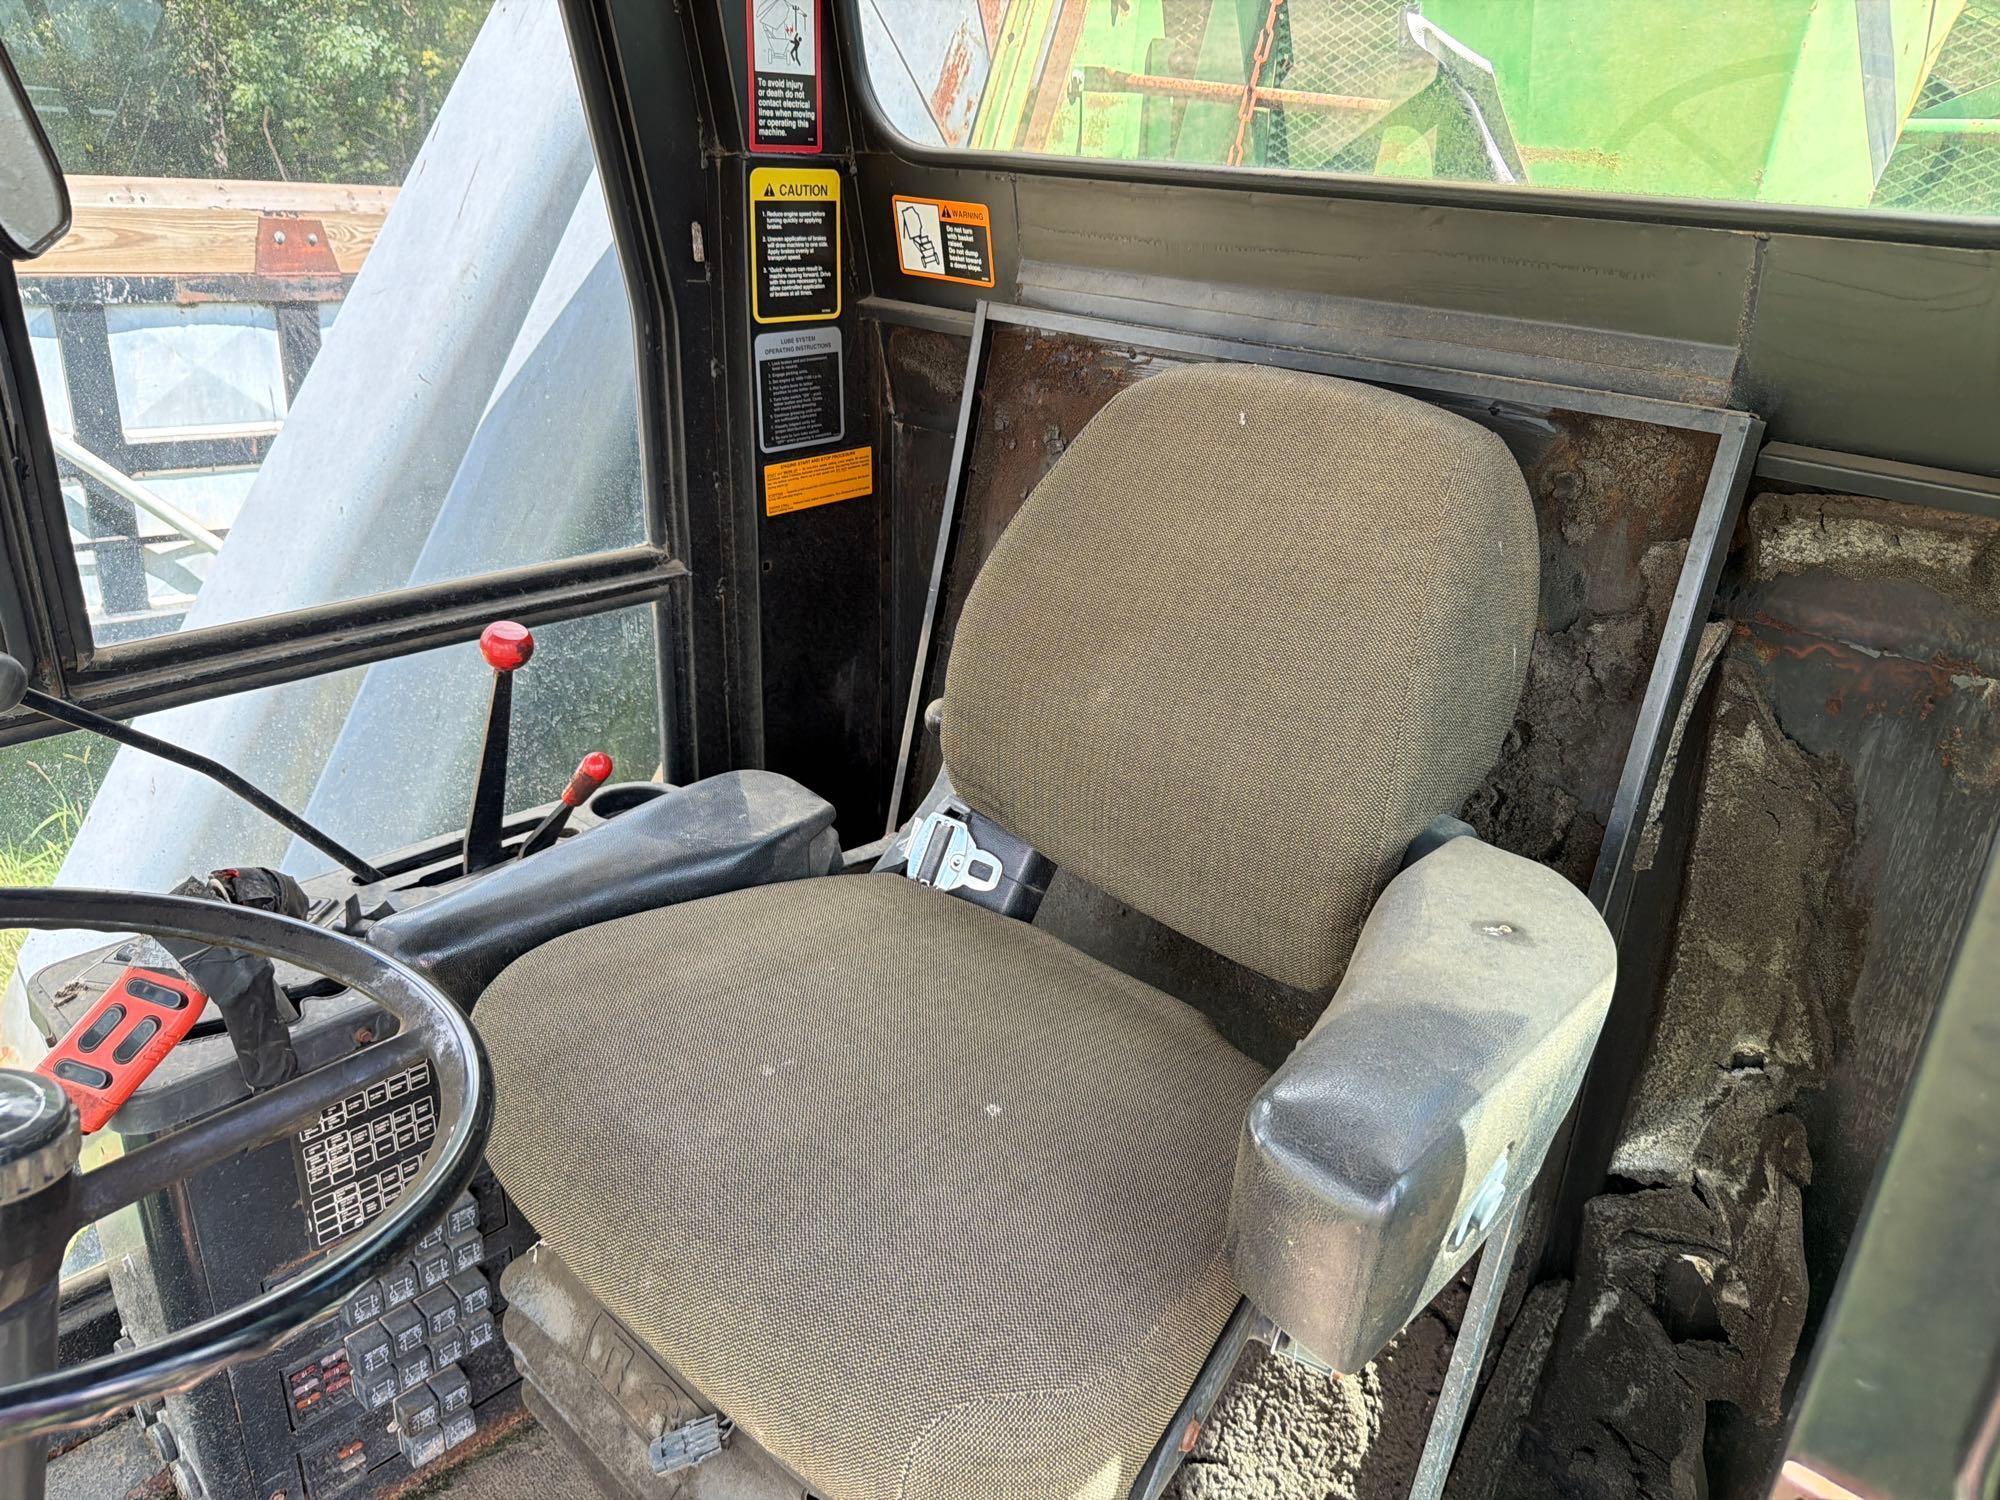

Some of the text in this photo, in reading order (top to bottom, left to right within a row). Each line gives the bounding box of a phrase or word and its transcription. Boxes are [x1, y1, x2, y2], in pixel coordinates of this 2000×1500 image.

[758, 78, 803, 90] To avoid injury
[766, 89, 784, 97] death
[783, 100, 810, 108] electrical
[759, 108, 773, 116] lines
[793, 110, 815, 120] moving
[767, 119, 796, 129] operating
[759, 128, 787, 136] machine.
[780, 184, 828, 196] CAUTION
[952, 210, 984, 220] WARNING
[958, 234, 974, 242] basket
[965, 250, 978, 258] dump
[955, 261, 967, 270] down
[966, 257, 982, 265] toward
[765, 343, 831, 355] OPERATING INSTRUCTIONS
